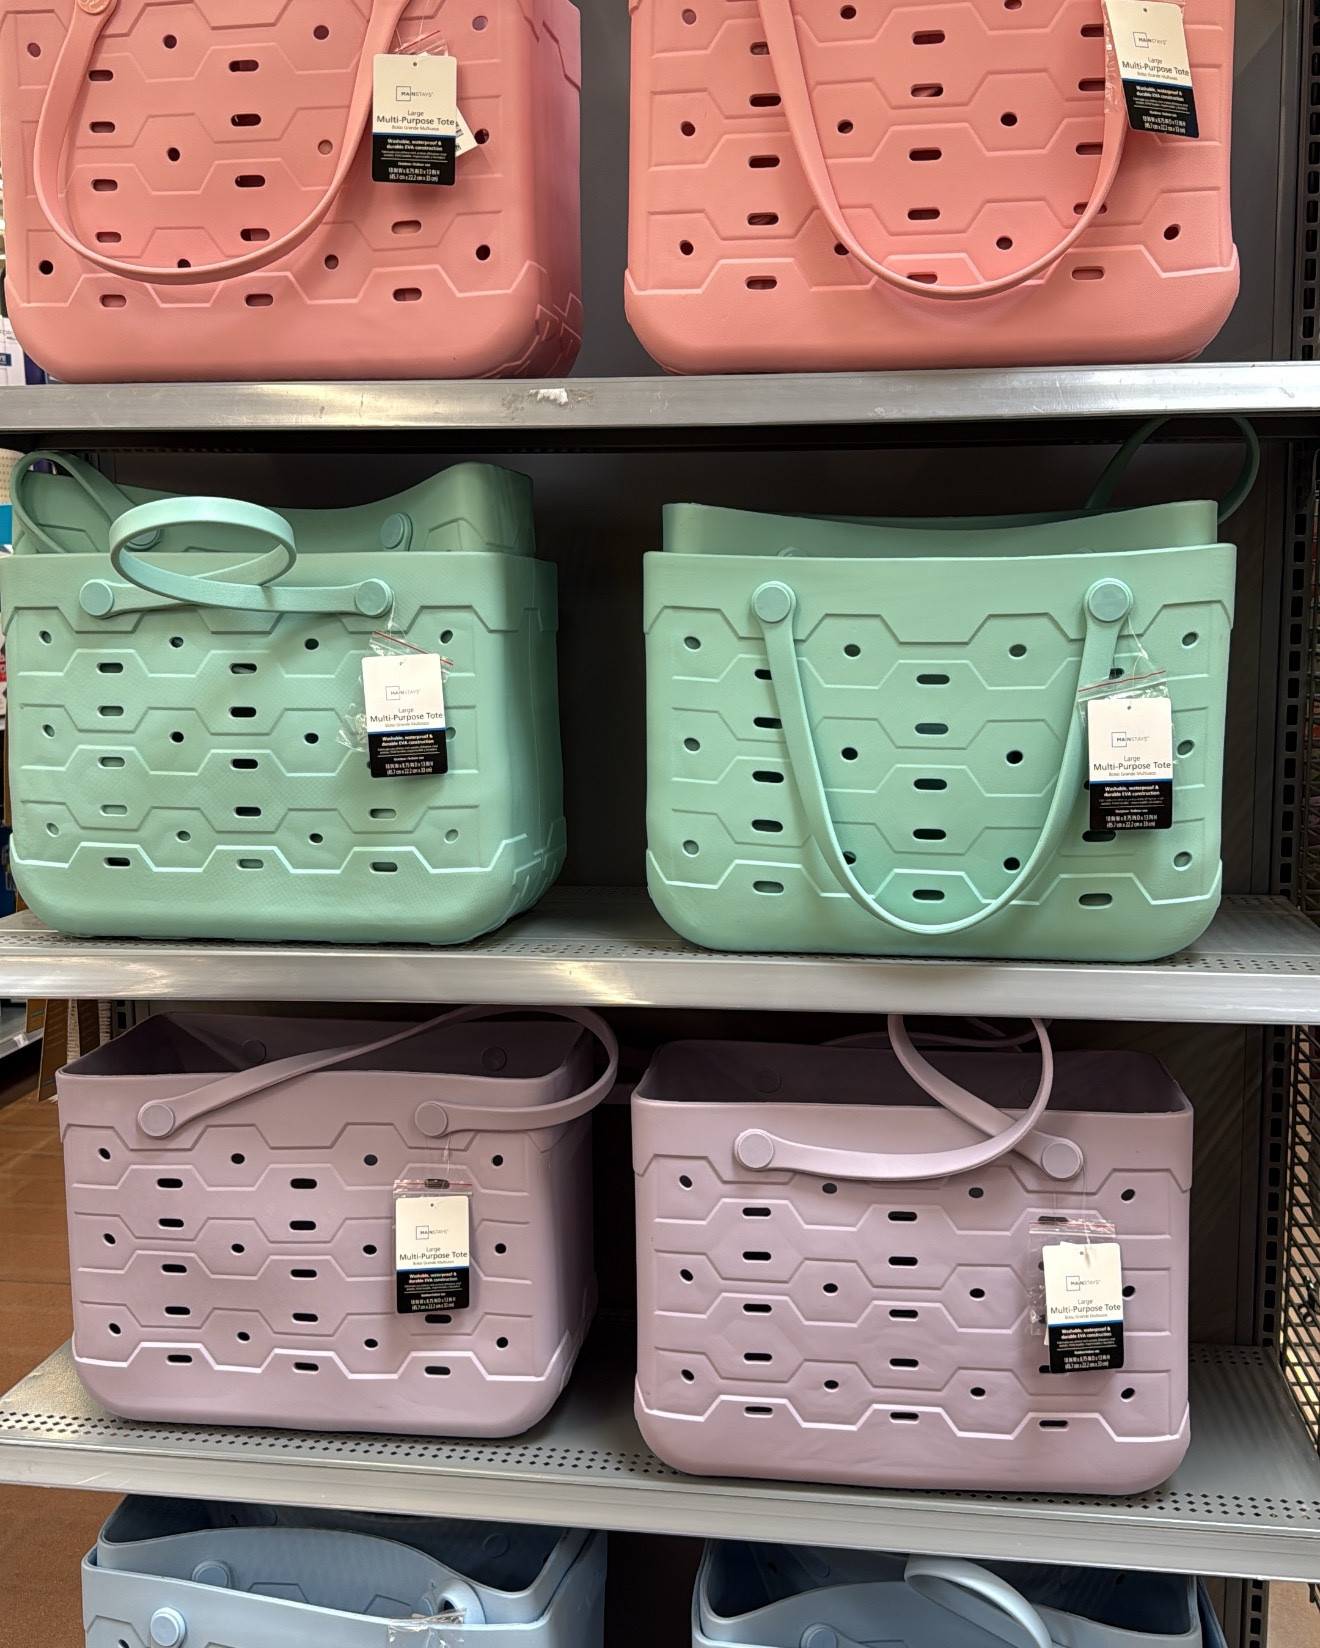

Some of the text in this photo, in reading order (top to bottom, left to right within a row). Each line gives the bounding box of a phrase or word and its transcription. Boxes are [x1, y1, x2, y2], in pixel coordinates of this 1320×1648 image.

[1122, 61, 1189, 76] Multi-Purpose Tote
[377, 116, 434, 125] Multi-Purpose
[370, 713, 424, 722] Multi-Purpose
[1093, 763, 1151, 771] Multi-Purpose
[1051, 1306, 1103, 1314] Multi-Purpose
